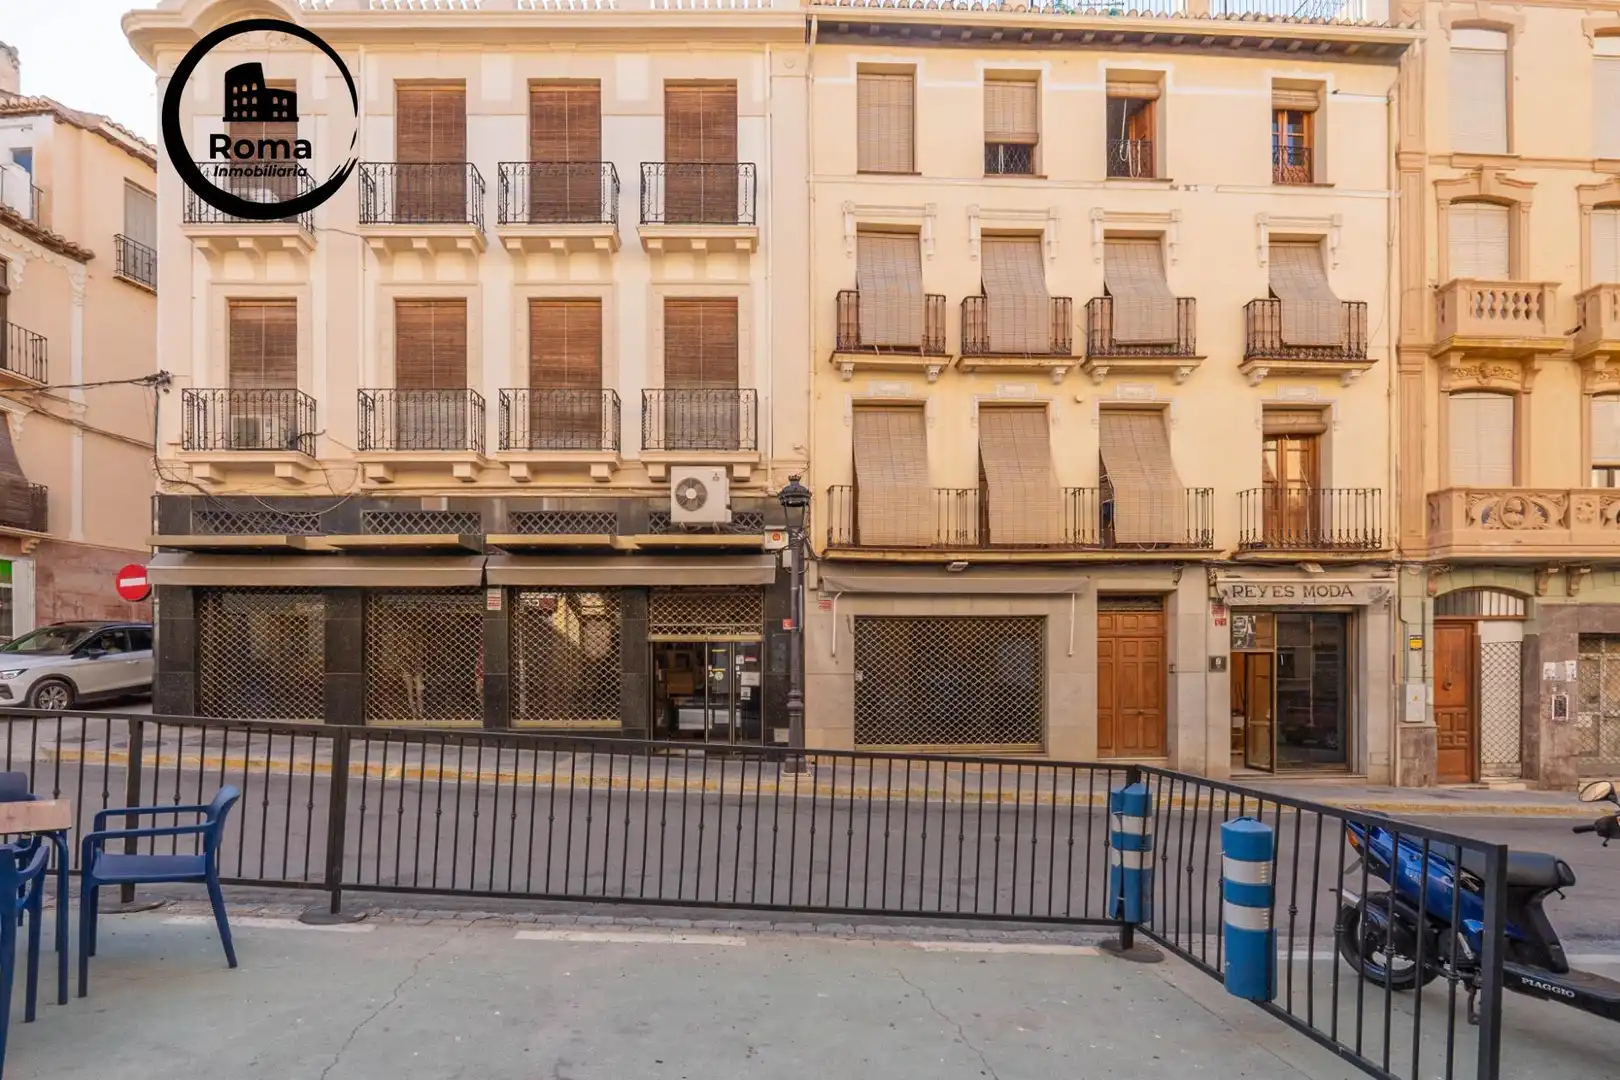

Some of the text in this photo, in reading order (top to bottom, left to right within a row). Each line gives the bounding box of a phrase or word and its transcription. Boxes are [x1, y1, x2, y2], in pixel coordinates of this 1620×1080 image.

[1231, 583, 1354, 598] REYES MODA
[1521, 976, 1575, 998] PIAGGIO
